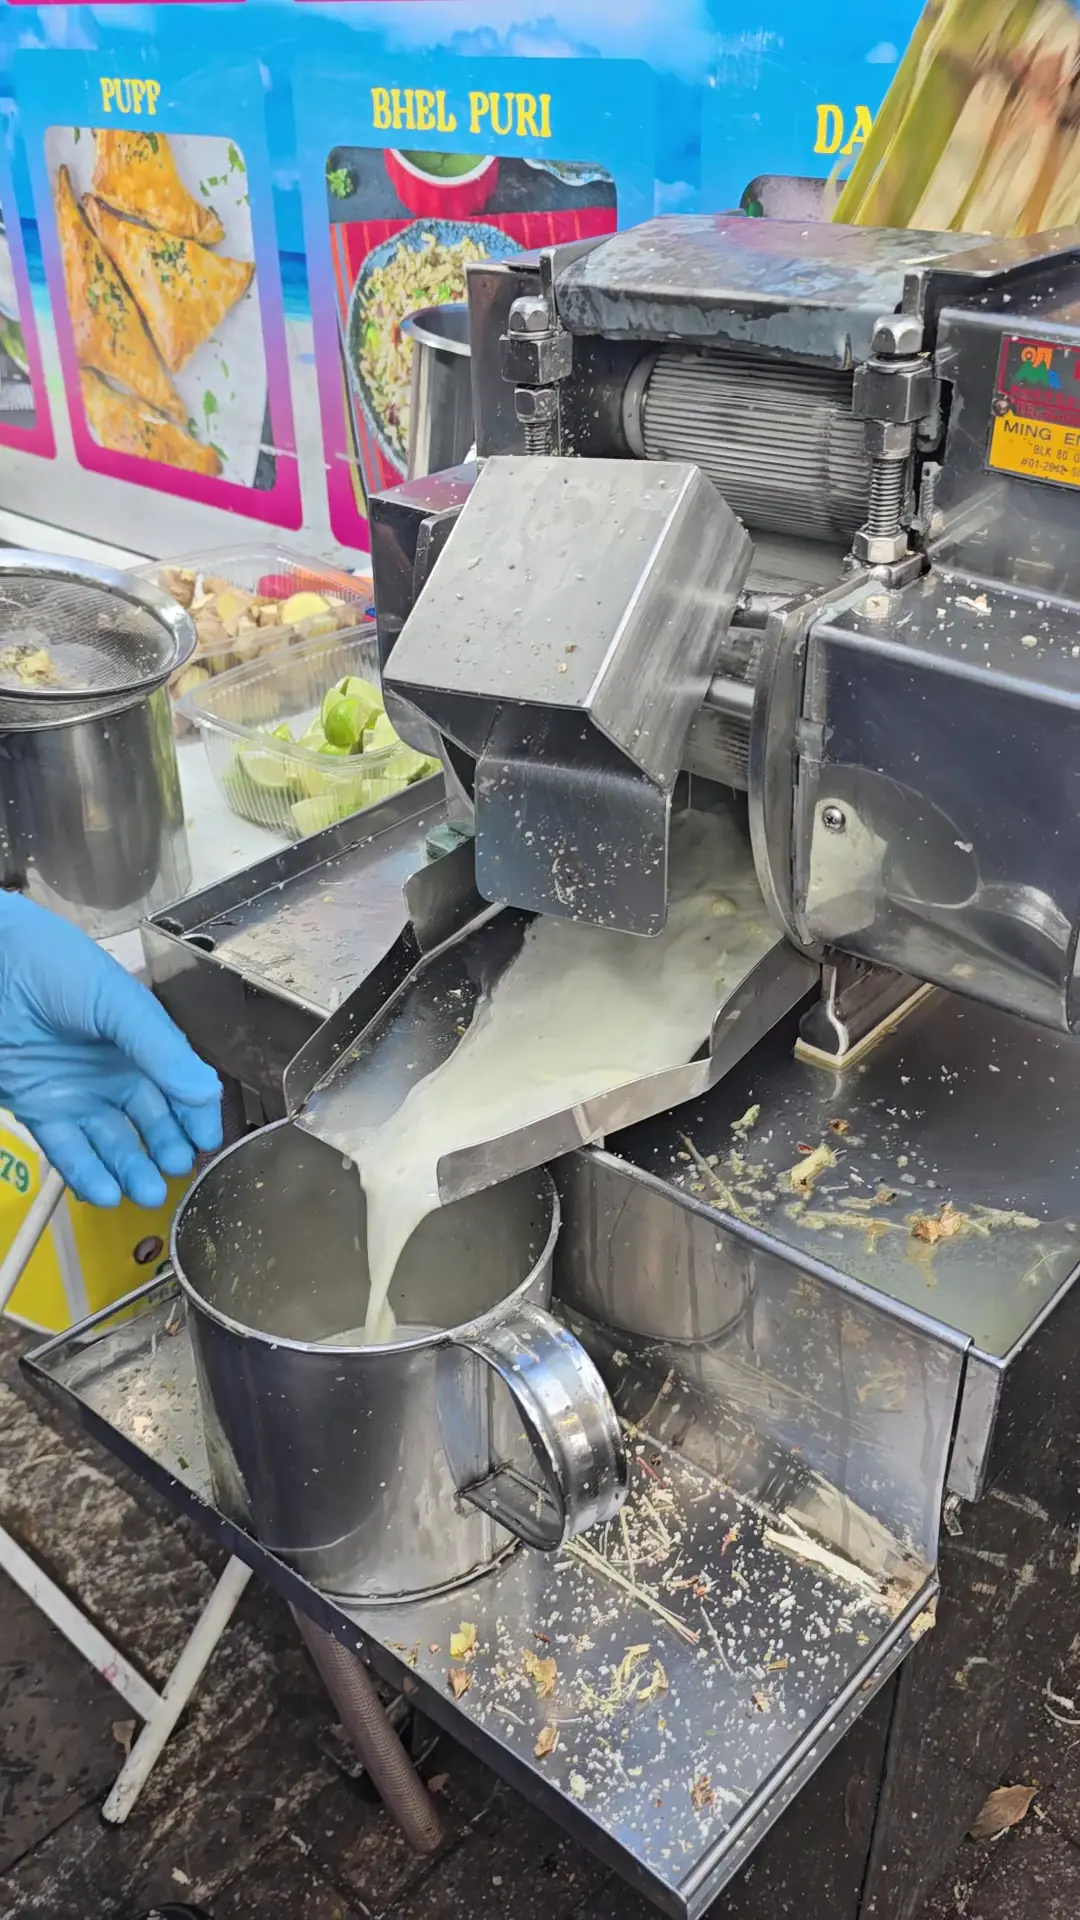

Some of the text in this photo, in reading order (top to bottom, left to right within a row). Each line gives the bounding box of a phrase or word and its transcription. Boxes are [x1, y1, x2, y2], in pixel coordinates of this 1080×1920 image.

[371, 87, 552, 138] BHEL PURI
[1003, 420, 1052, 440] MING
[1033, 444, 1052, 458] BLK
